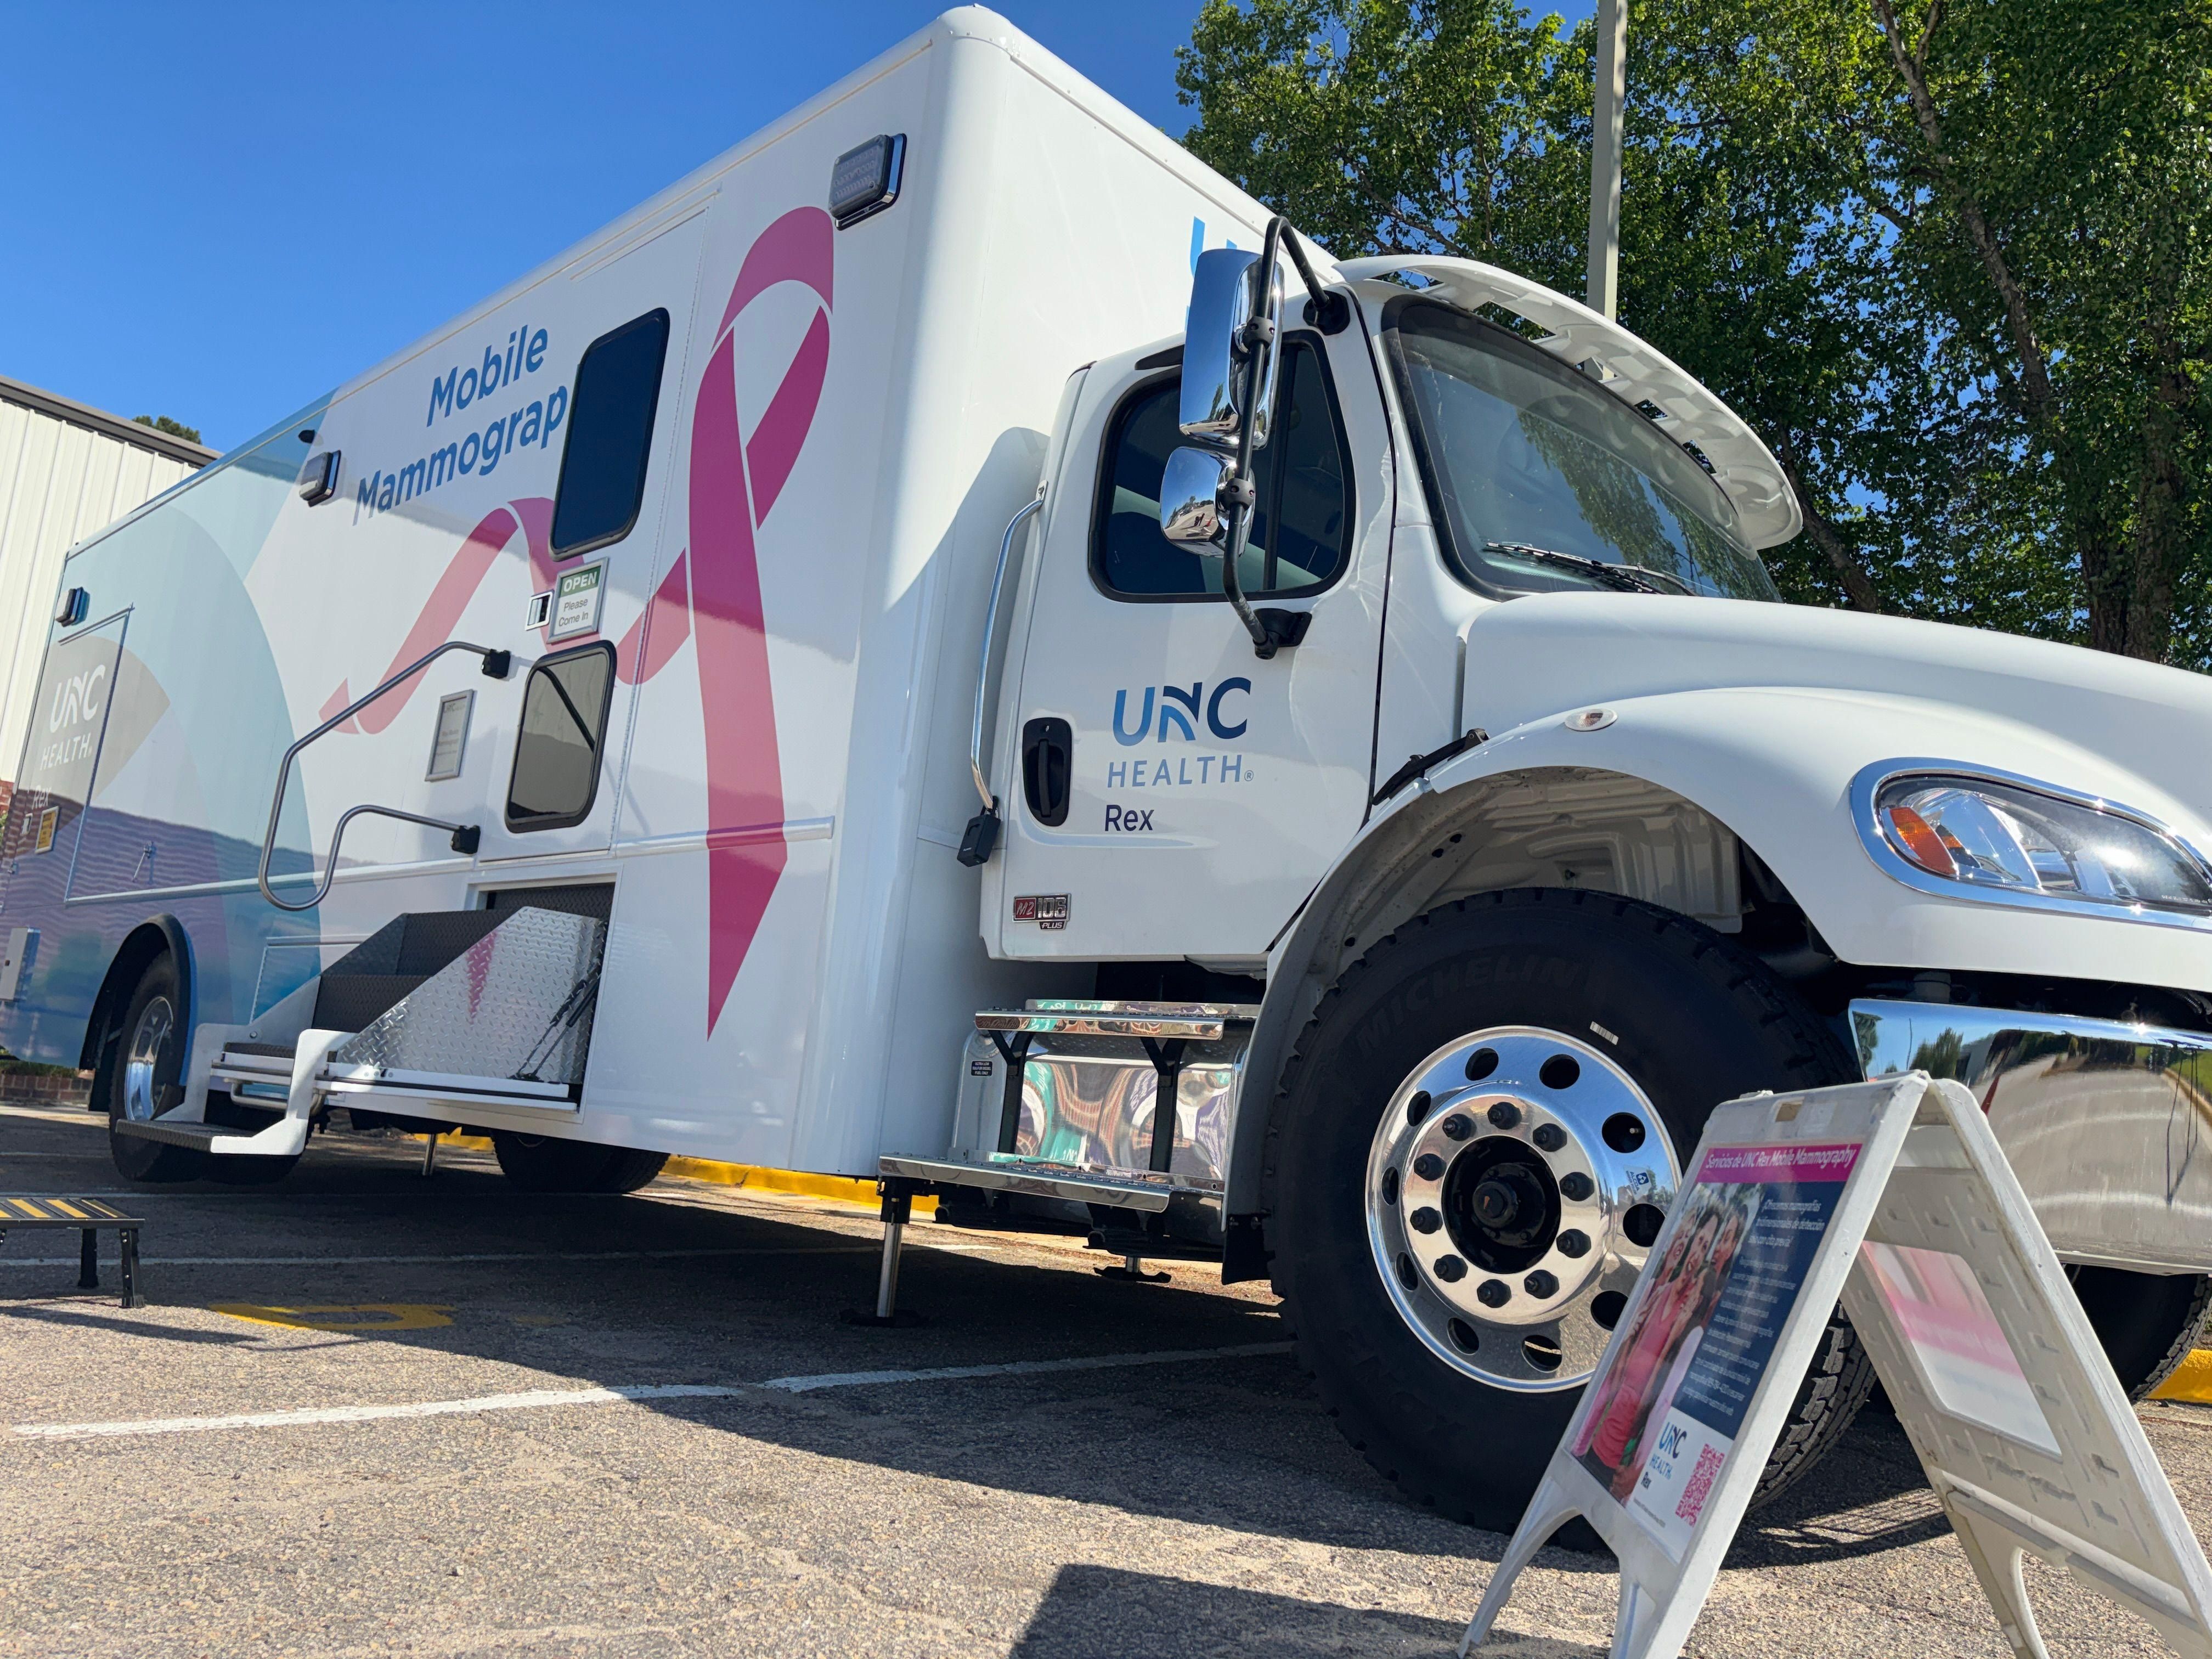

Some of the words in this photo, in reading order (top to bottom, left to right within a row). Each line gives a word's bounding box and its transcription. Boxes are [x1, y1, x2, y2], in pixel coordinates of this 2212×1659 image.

[427, 324, 548, 427] Mobile
[563, 571, 597, 592] OPEN
[563, 599, 588, 612] Please
[558, 613, 580, 627] Come
[581, 611, 589, 620] In
[49, 664, 105, 733] UNC
[1113, 677, 1251, 746] UNC
[31, 785, 52, 810] Rex
[1105, 804, 1154, 832] Rex
[1016, 901, 1035, 916] M2
[1037, 898, 1066, 918] 106
[1356, 953, 1581, 1053] MICHELIN
[1706, 1154, 1732, 1169] Servicios
[1731, 1154, 1742, 1168] de
[1742, 1152, 1759, 1168] UNC
[1758, 1151, 1772, 1167] Rex
[1771, 1149, 1795, 1166] Mobile
[1794, 1144, 1857, 1169] Mammography
[1630, 1171, 1640, 1191] ALCOA
[1658, 1421, 1687, 1459] UNC
